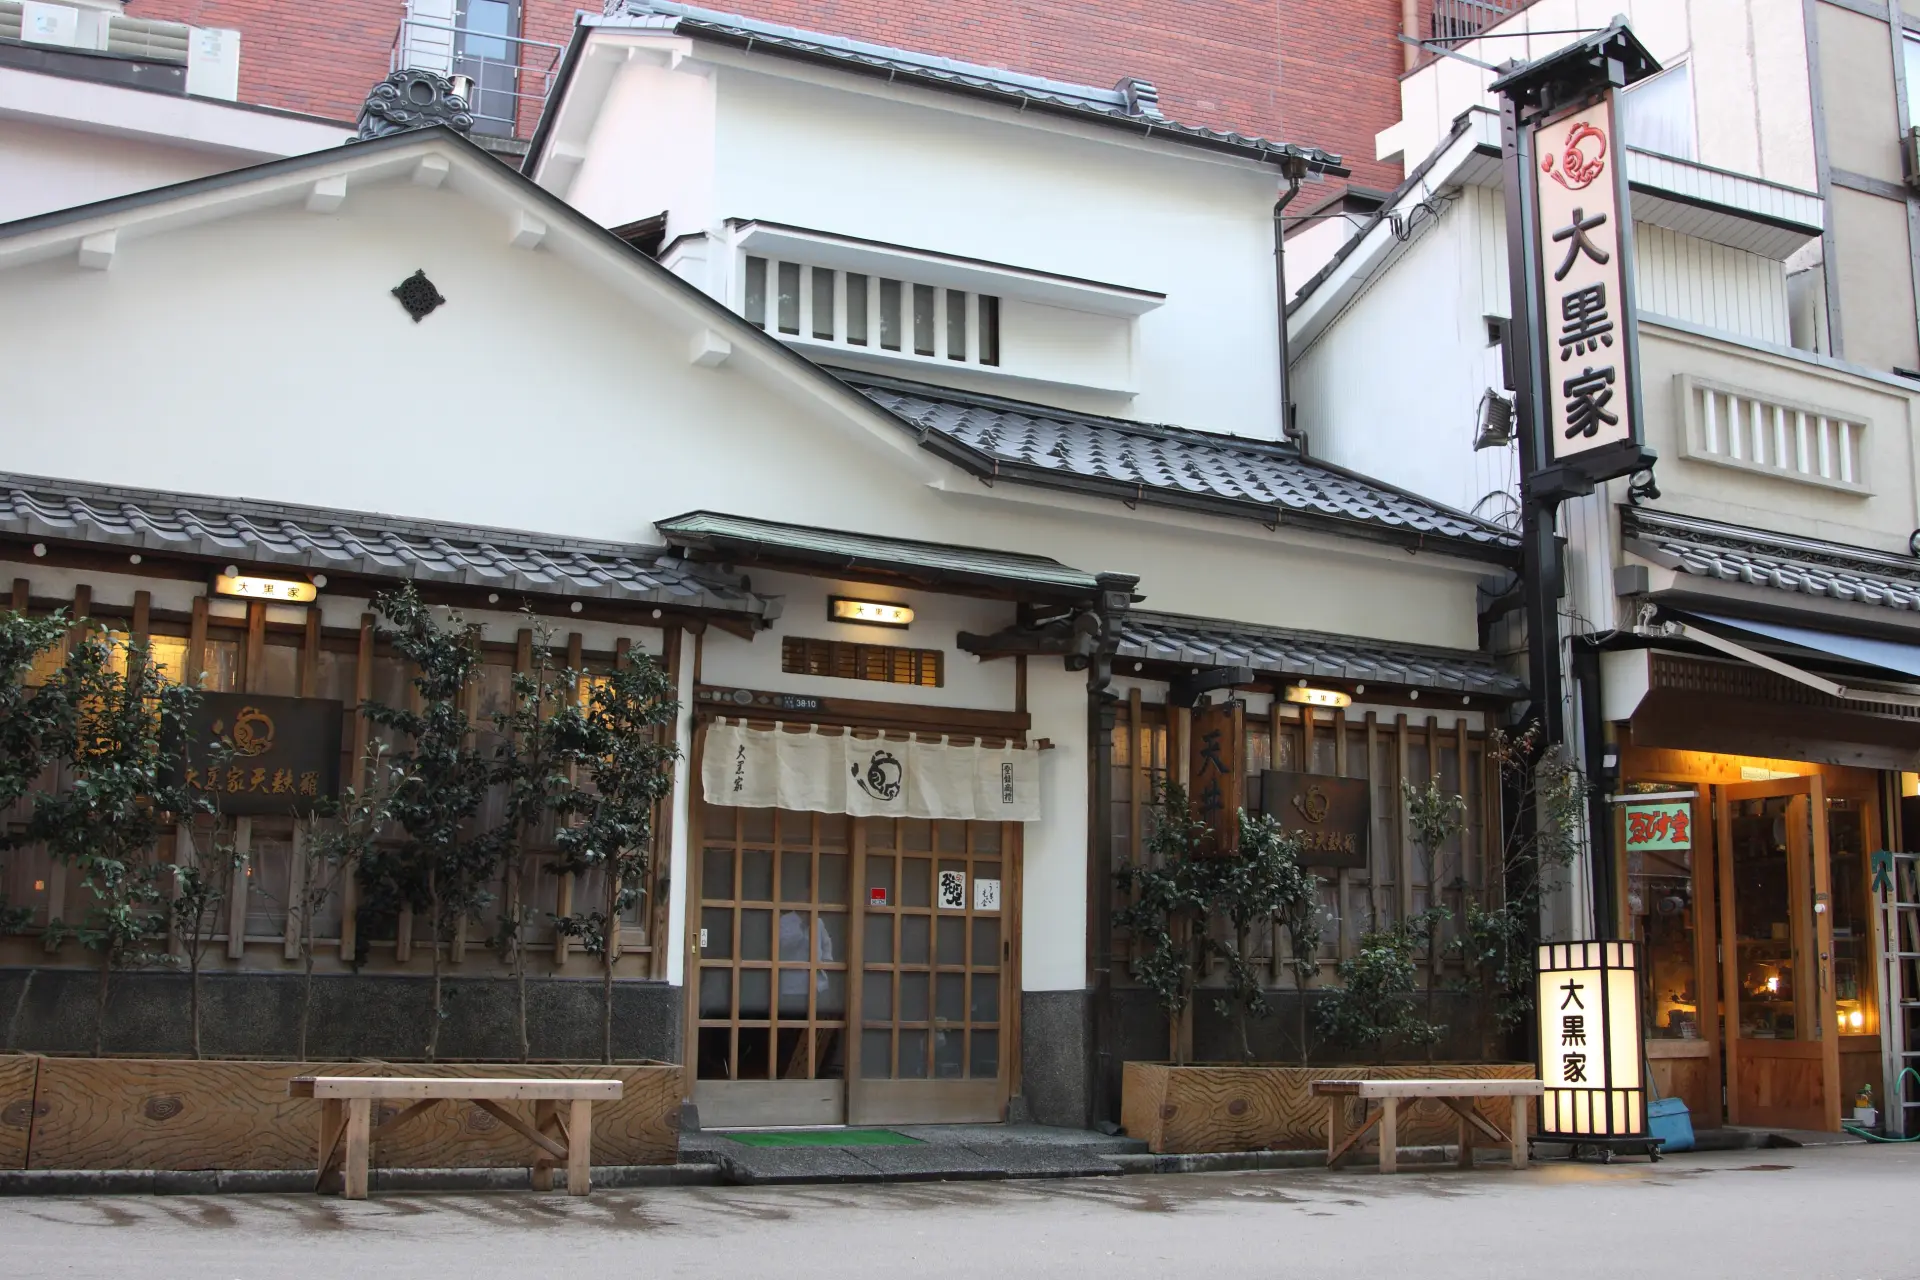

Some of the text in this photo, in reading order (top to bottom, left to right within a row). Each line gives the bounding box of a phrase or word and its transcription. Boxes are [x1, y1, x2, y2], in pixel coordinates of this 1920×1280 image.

[1552, 206, 1619, 440] 大黒家
[237, 582, 300, 598] 大黒家
[734, 744, 746, 792] 大黒家
[1627, 809, 1690, 844] ゑびす堂
[1560, 978, 1588, 1083] 大黒家
